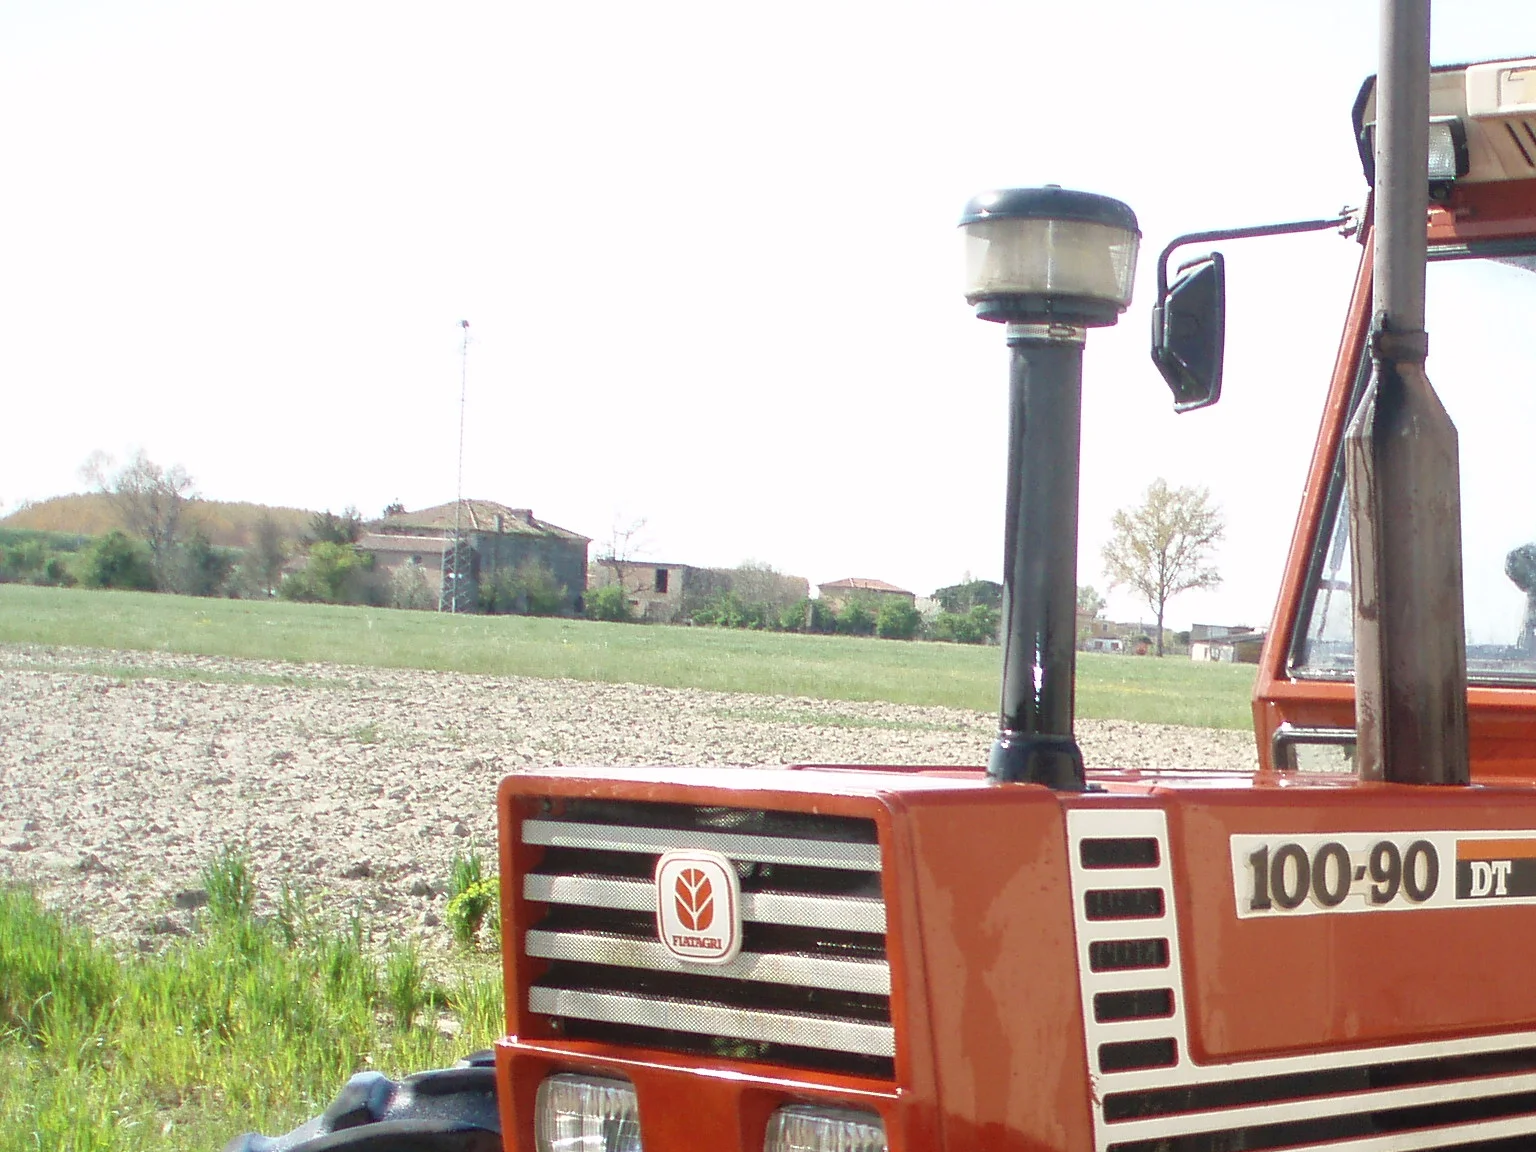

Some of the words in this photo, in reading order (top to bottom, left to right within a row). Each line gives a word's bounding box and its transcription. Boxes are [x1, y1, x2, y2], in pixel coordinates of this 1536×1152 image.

[1246, 839, 1440, 910] 100-90
[1469, 861, 1512, 897] DT
[672, 935, 723, 950] FIATAGRI
